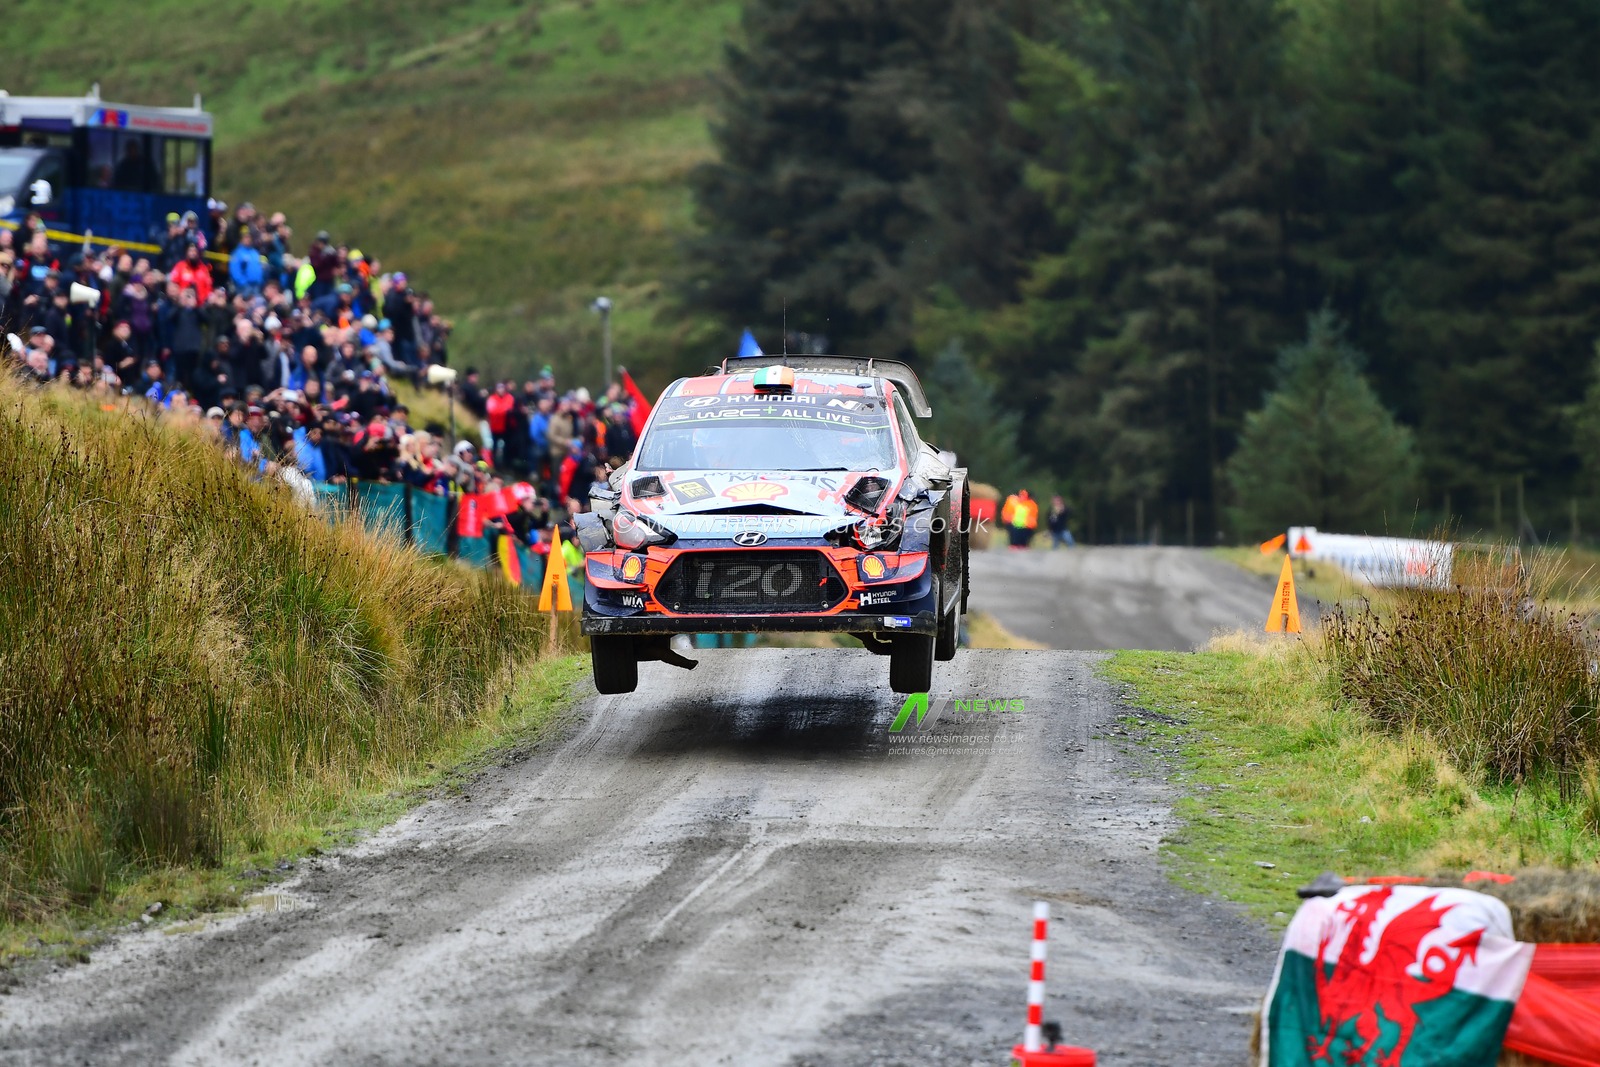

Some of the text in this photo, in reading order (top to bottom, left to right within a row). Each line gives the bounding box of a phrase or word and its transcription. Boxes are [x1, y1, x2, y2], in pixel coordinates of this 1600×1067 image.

[726, 394, 816, 405] HYUNDAI
[782, 409, 812, 419] ALL
[816, 411, 851, 424] LIVE
[728, 474, 837, 492] MOBIS
[695, 561, 802, 599] i20
[872, 590, 897, 598] HYUNDAI
